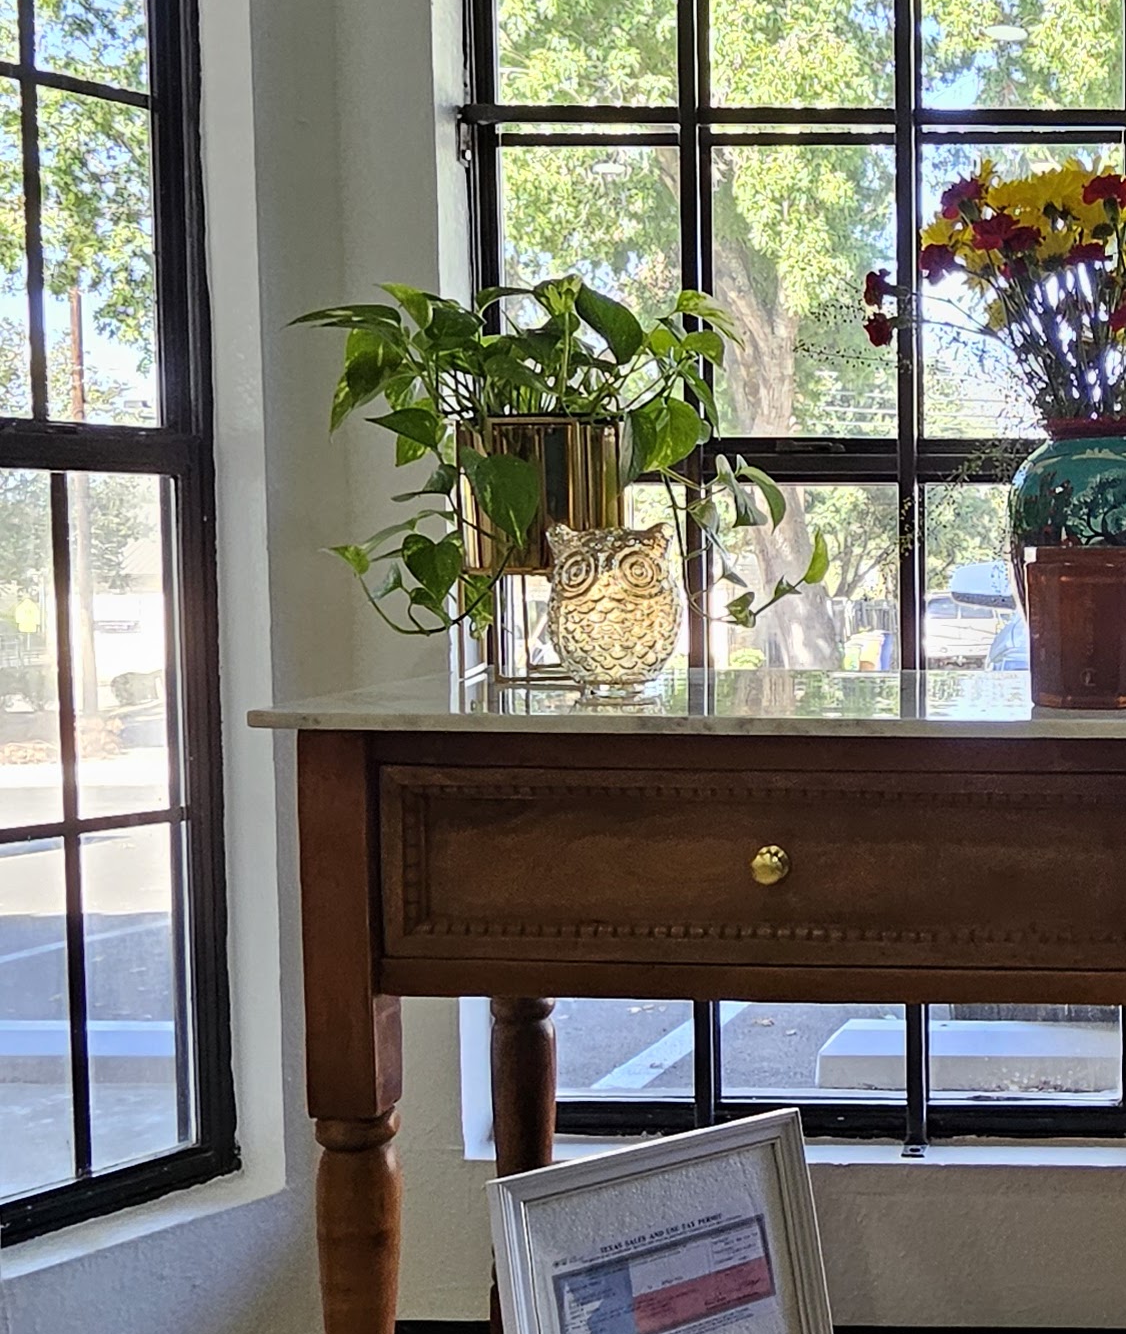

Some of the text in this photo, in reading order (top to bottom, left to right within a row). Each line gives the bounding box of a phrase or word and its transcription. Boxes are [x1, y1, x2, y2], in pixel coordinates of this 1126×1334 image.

[600, 1213, 722, 1253] TEXAS SALES AND USE TAX PERMIT
